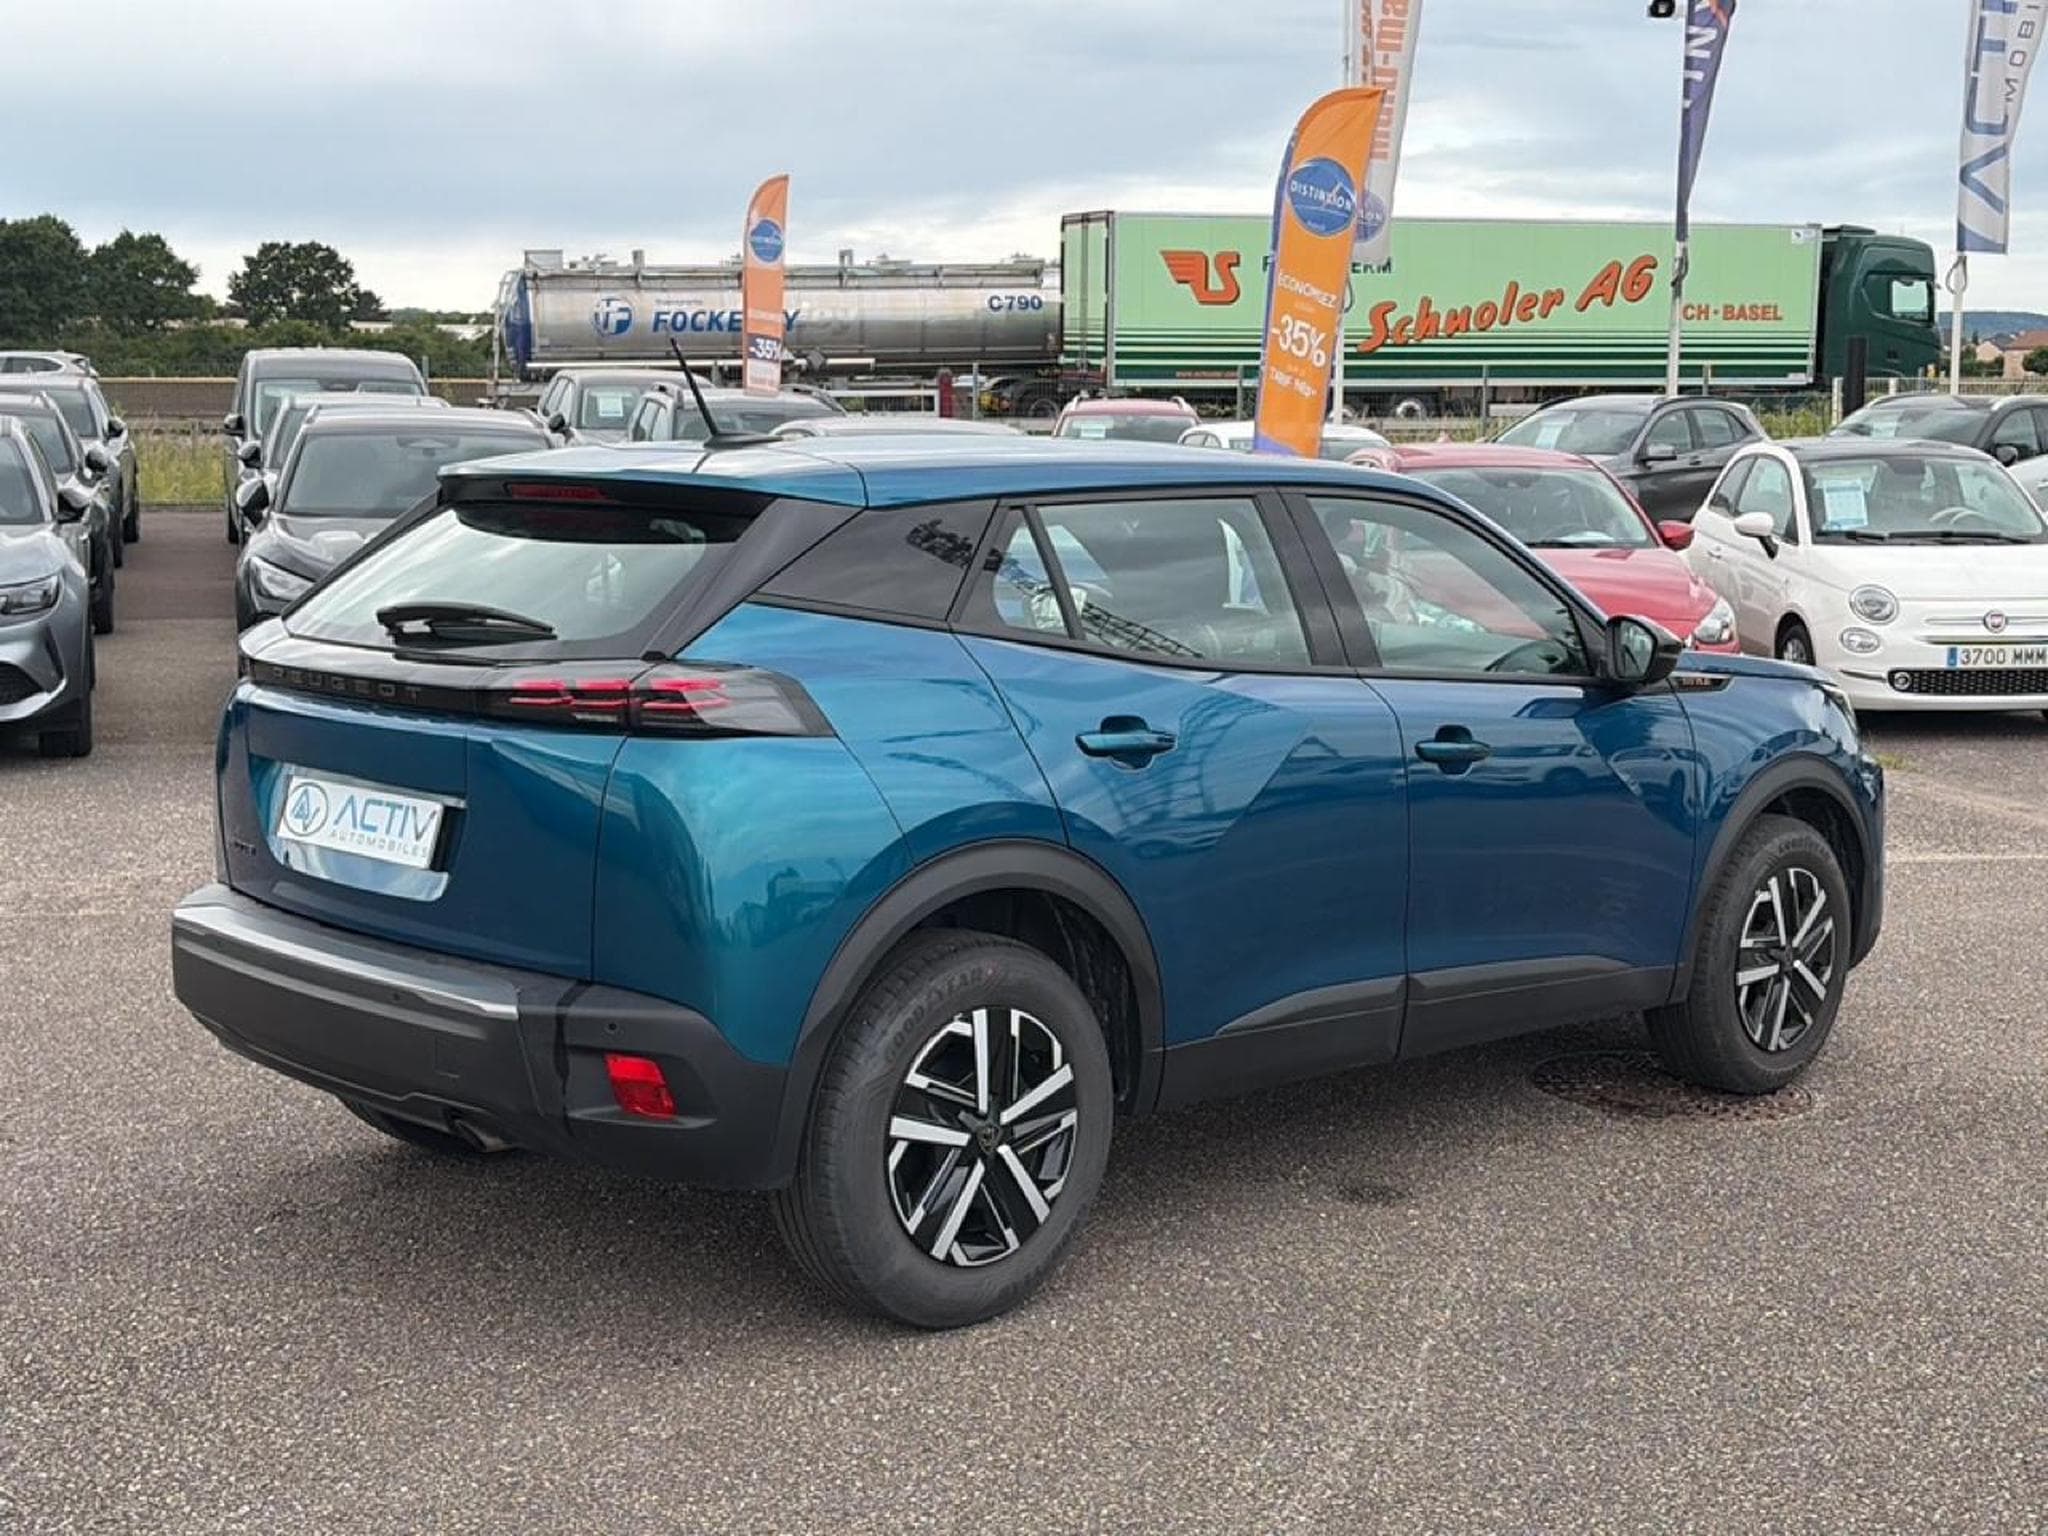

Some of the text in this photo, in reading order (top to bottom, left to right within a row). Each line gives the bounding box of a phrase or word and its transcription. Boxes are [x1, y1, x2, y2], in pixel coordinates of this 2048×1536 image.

[1575, 254, 1657, 312] AG
[988, 295, 1042, 312] C790
[1683, 304, 1782, 320] CH BASEL
[653, 310, 799, 332] FOCKEY
[1271, 314, 1326, 367] -35%
[1961, 648, 2006, 665] 3700
[273, 666, 421, 699] PEUGEOT
[333, 795, 438, 842] ACTIV
[328, 829, 428, 859] AUTOMOBILES
